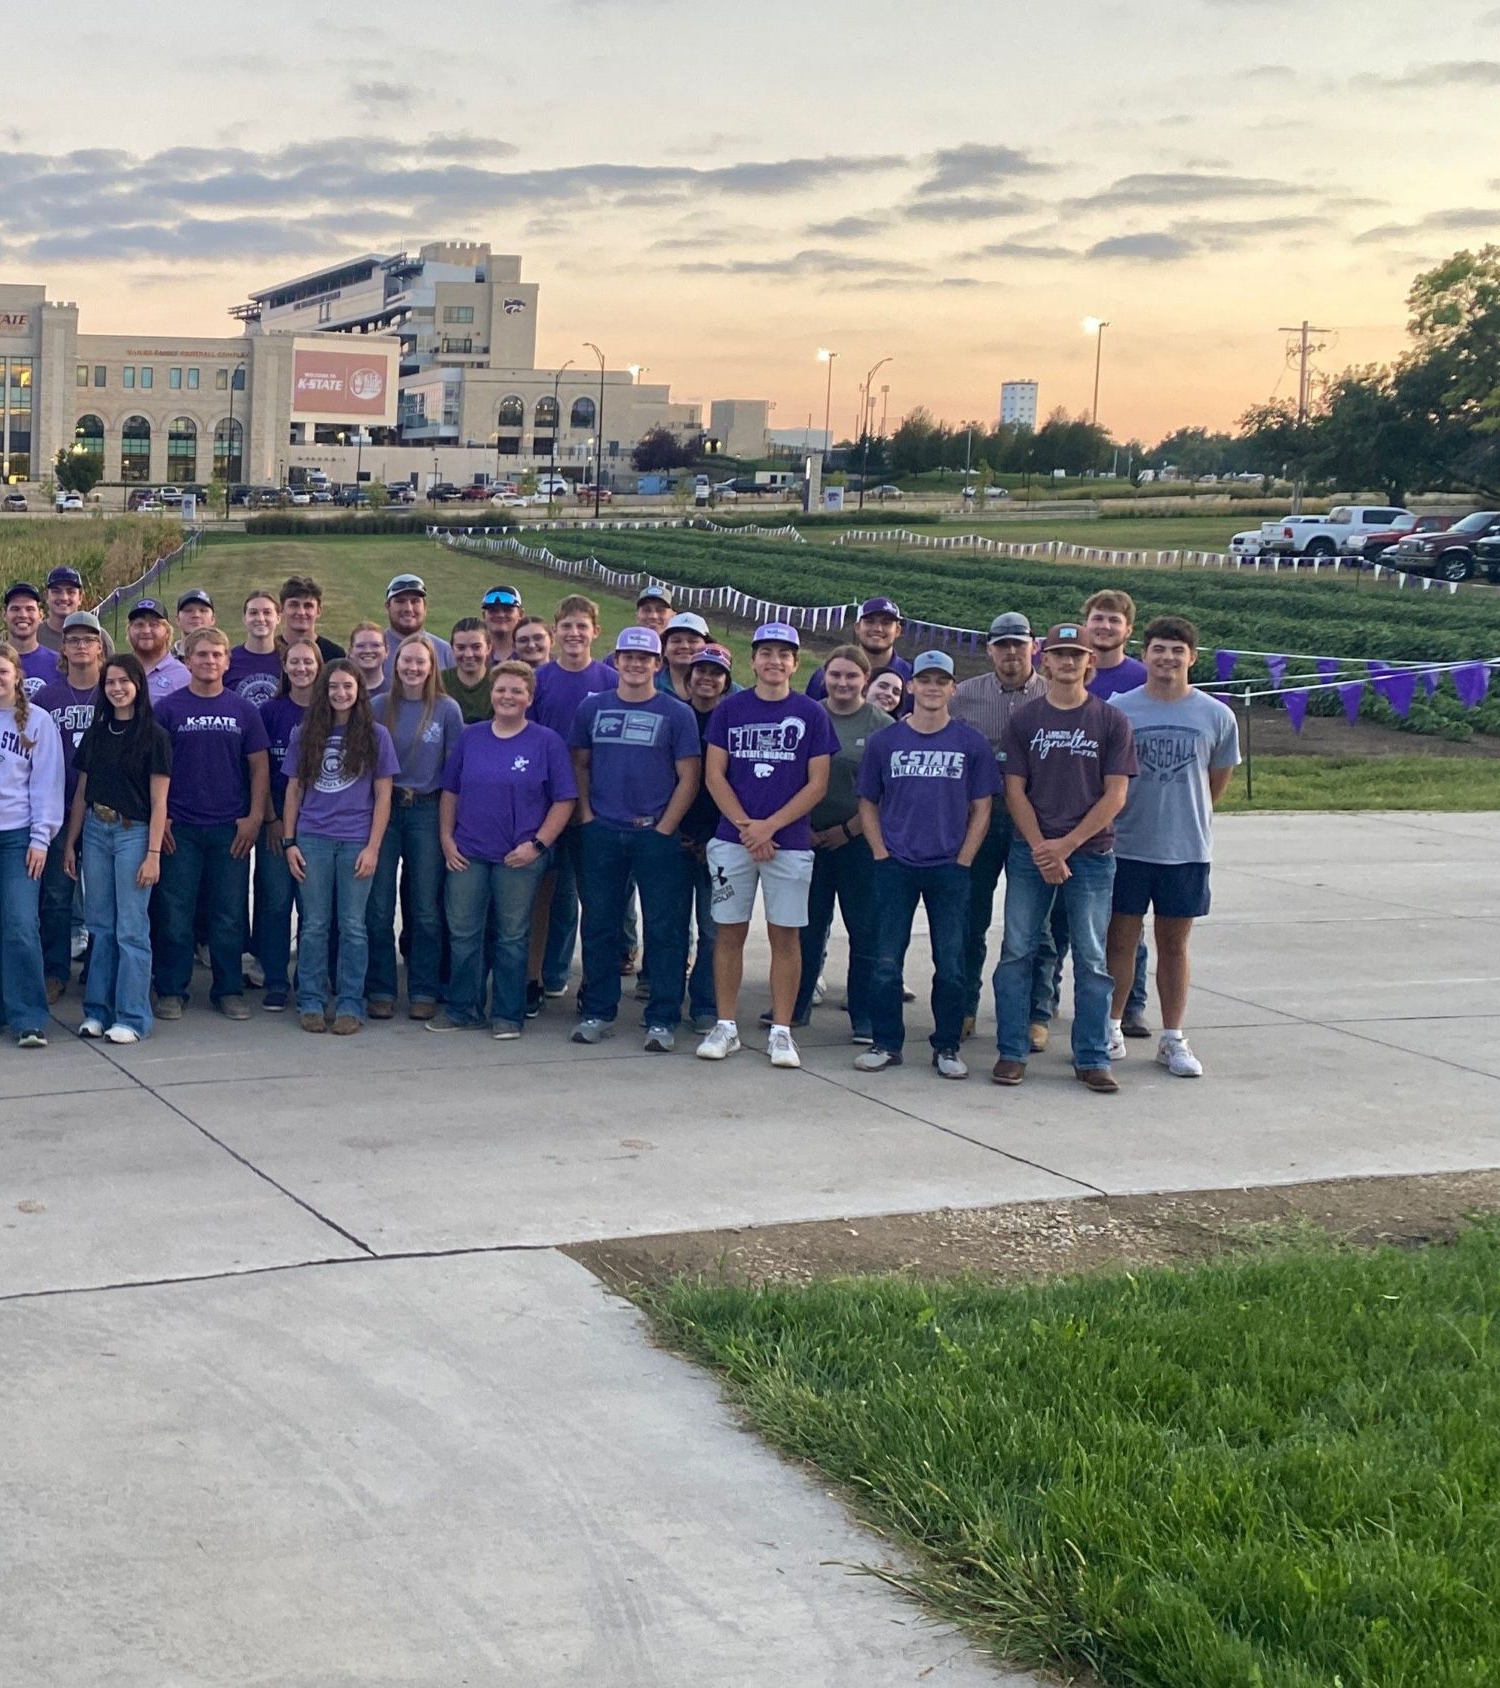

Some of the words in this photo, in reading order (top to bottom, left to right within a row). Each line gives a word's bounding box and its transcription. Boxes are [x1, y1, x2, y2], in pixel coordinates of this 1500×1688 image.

[298, 378, 343, 391] K-STATE
[187, 716, 236, 727] K-STATE
[177, 724, 242, 735] AGRICULTURE
[1030, 728, 1099, 760] Agriculture
[890, 750, 965, 768] K-STATE
[892, 766, 944, 776] WILDCATS
